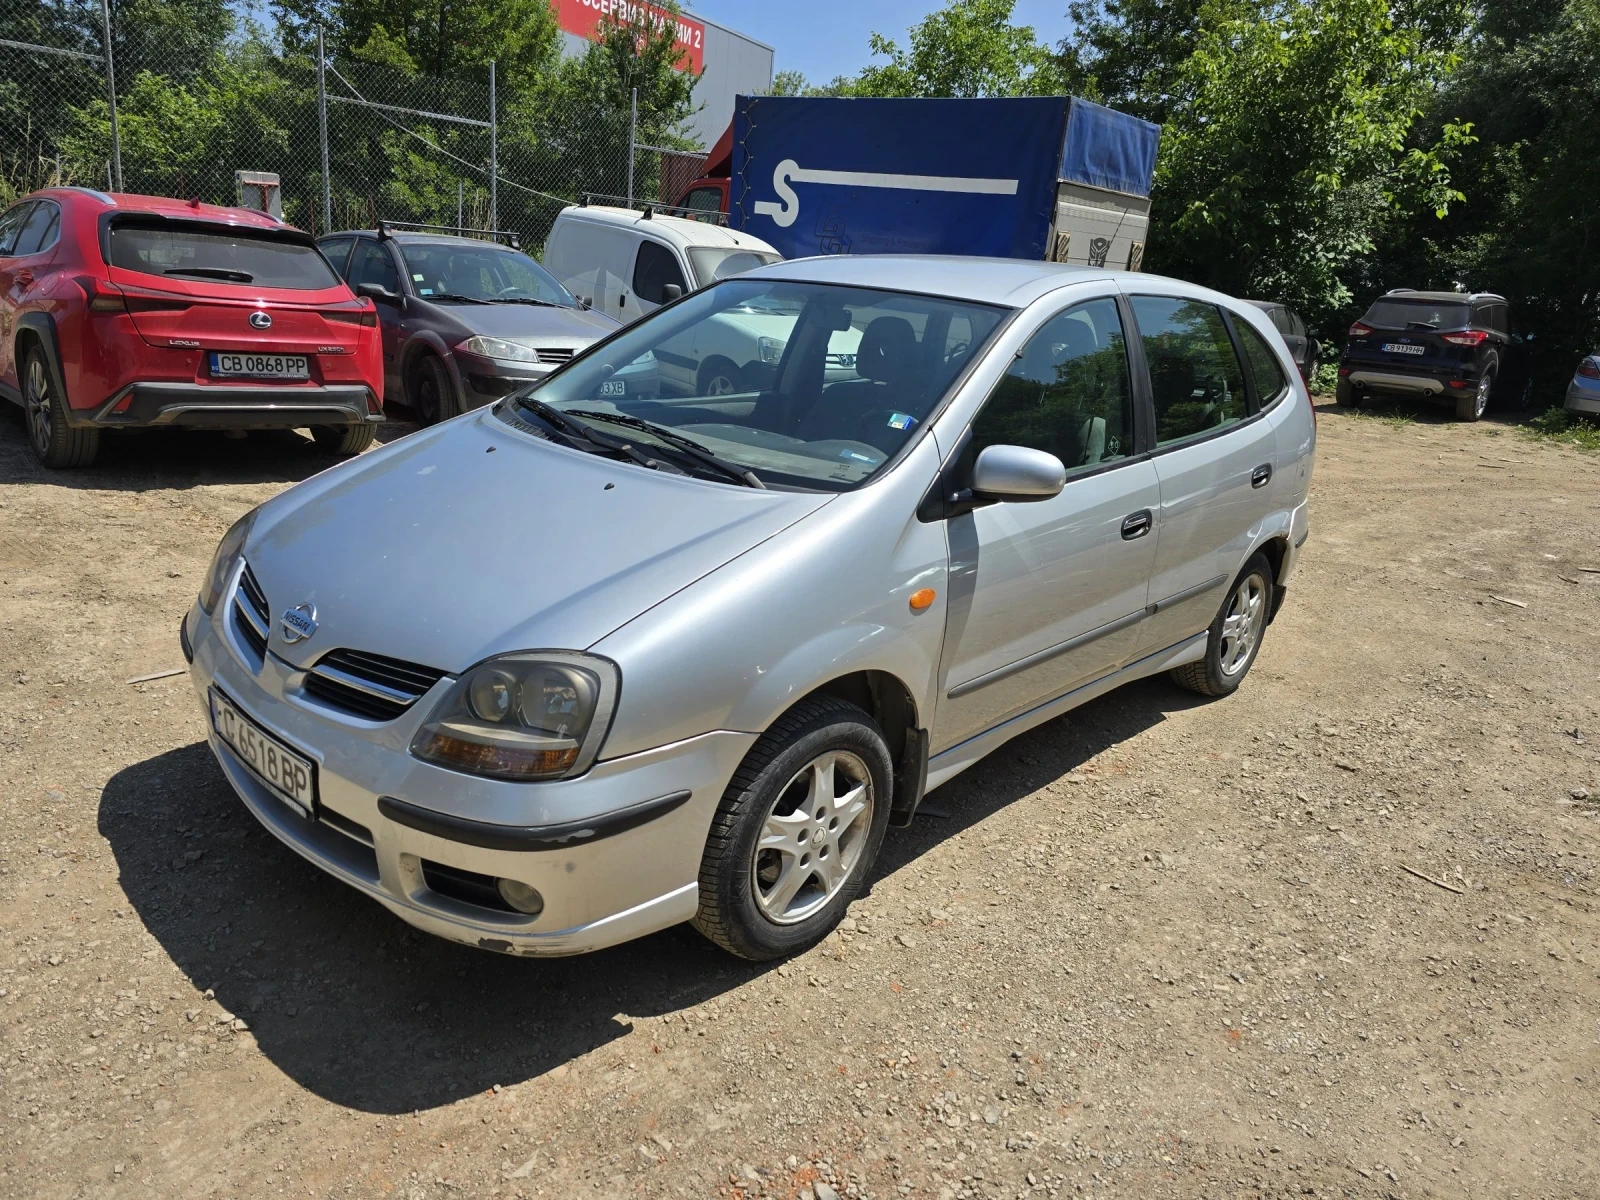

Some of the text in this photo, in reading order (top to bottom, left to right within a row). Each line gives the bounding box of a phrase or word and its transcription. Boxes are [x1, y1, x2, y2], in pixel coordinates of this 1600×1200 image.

[694, 29, 701, 49] 2
[221, 356, 306, 373] CB 0868 PP
[612, 382, 624, 394] XB
[284, 611, 310, 631] NISSAN
[223, 707, 307, 798] C 6518 BP
